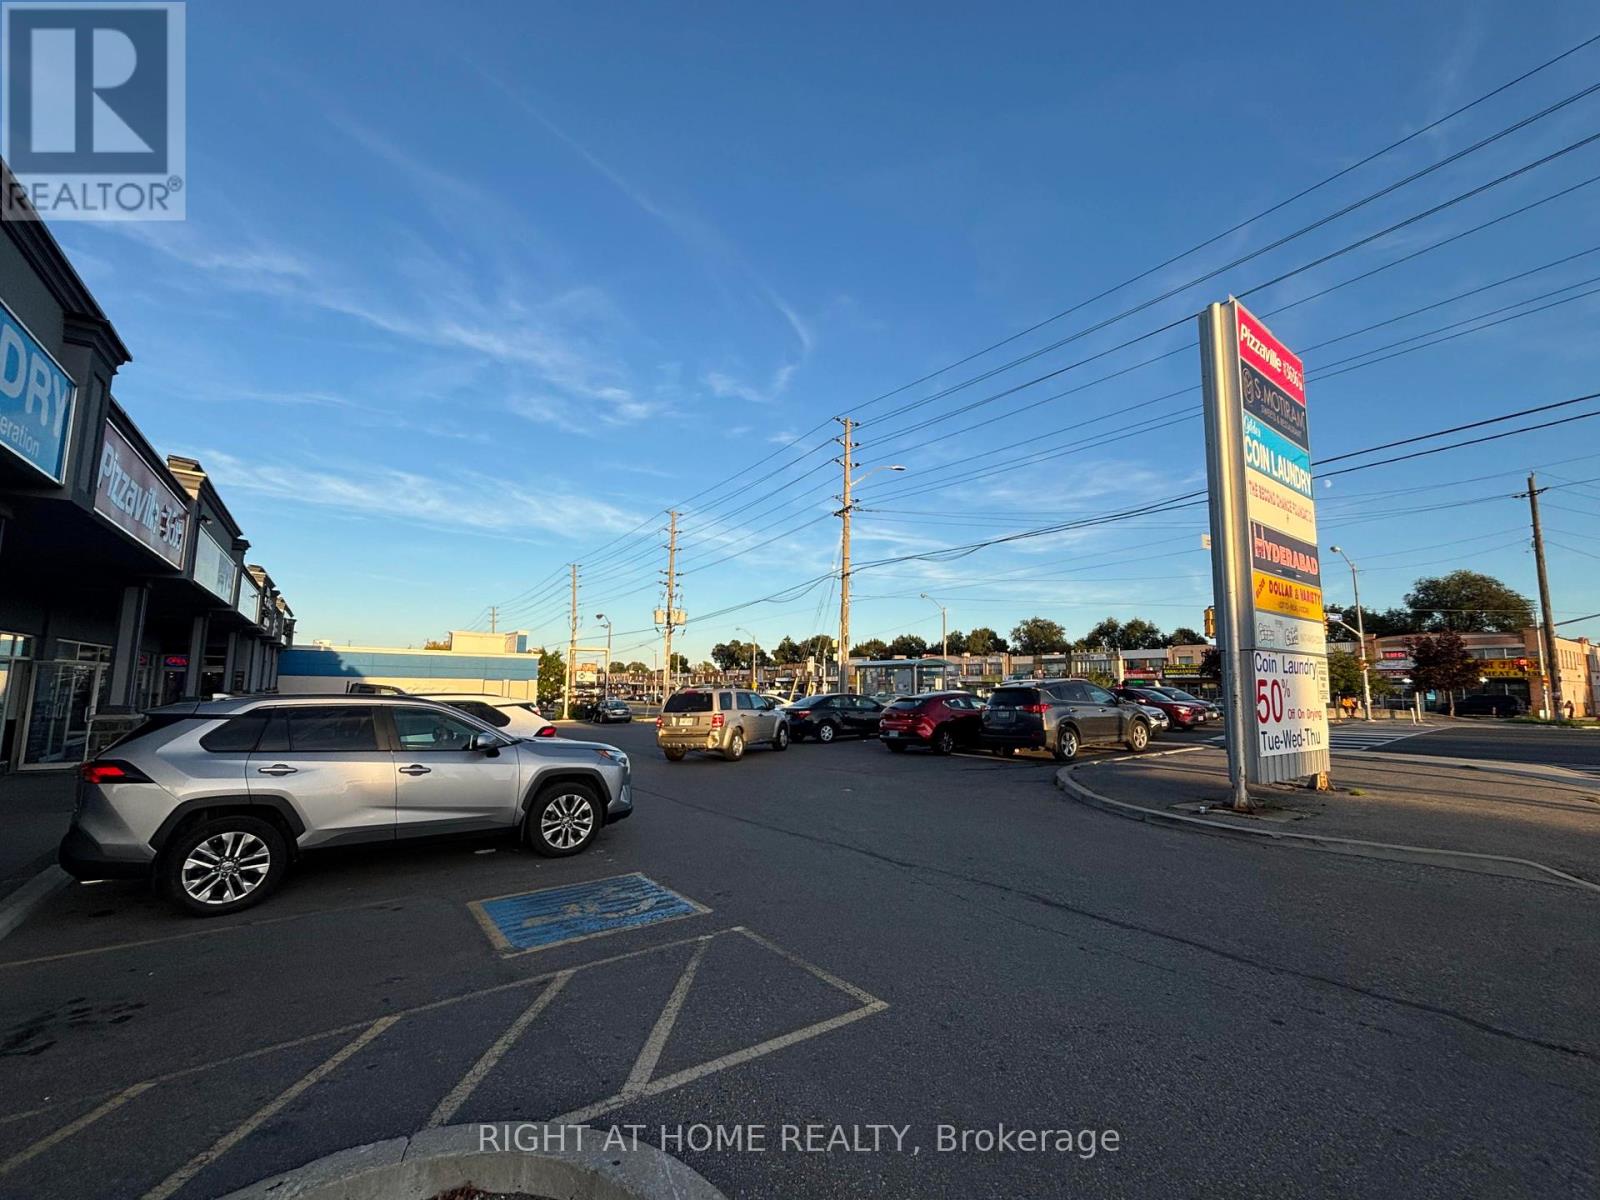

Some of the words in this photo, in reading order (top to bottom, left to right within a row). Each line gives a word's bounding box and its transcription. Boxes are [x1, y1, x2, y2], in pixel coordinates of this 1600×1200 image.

[1240, 323, 1282, 372] Pizzaville
[0, 323, 70, 438] DRY
[0, 415, 40, 458] eration
[1244, 436, 1270, 472] COIN
[1271, 450, 1312, 496] LAUNDRY
[1254, 523, 1318, 575] HYDERABAD
[1269, 580, 1292, 599] DOLLAR
[1254, 652, 1277, 673] Coin
[1282, 655, 1318, 680] Laundry
[1297, 708, 1305, 720] On
